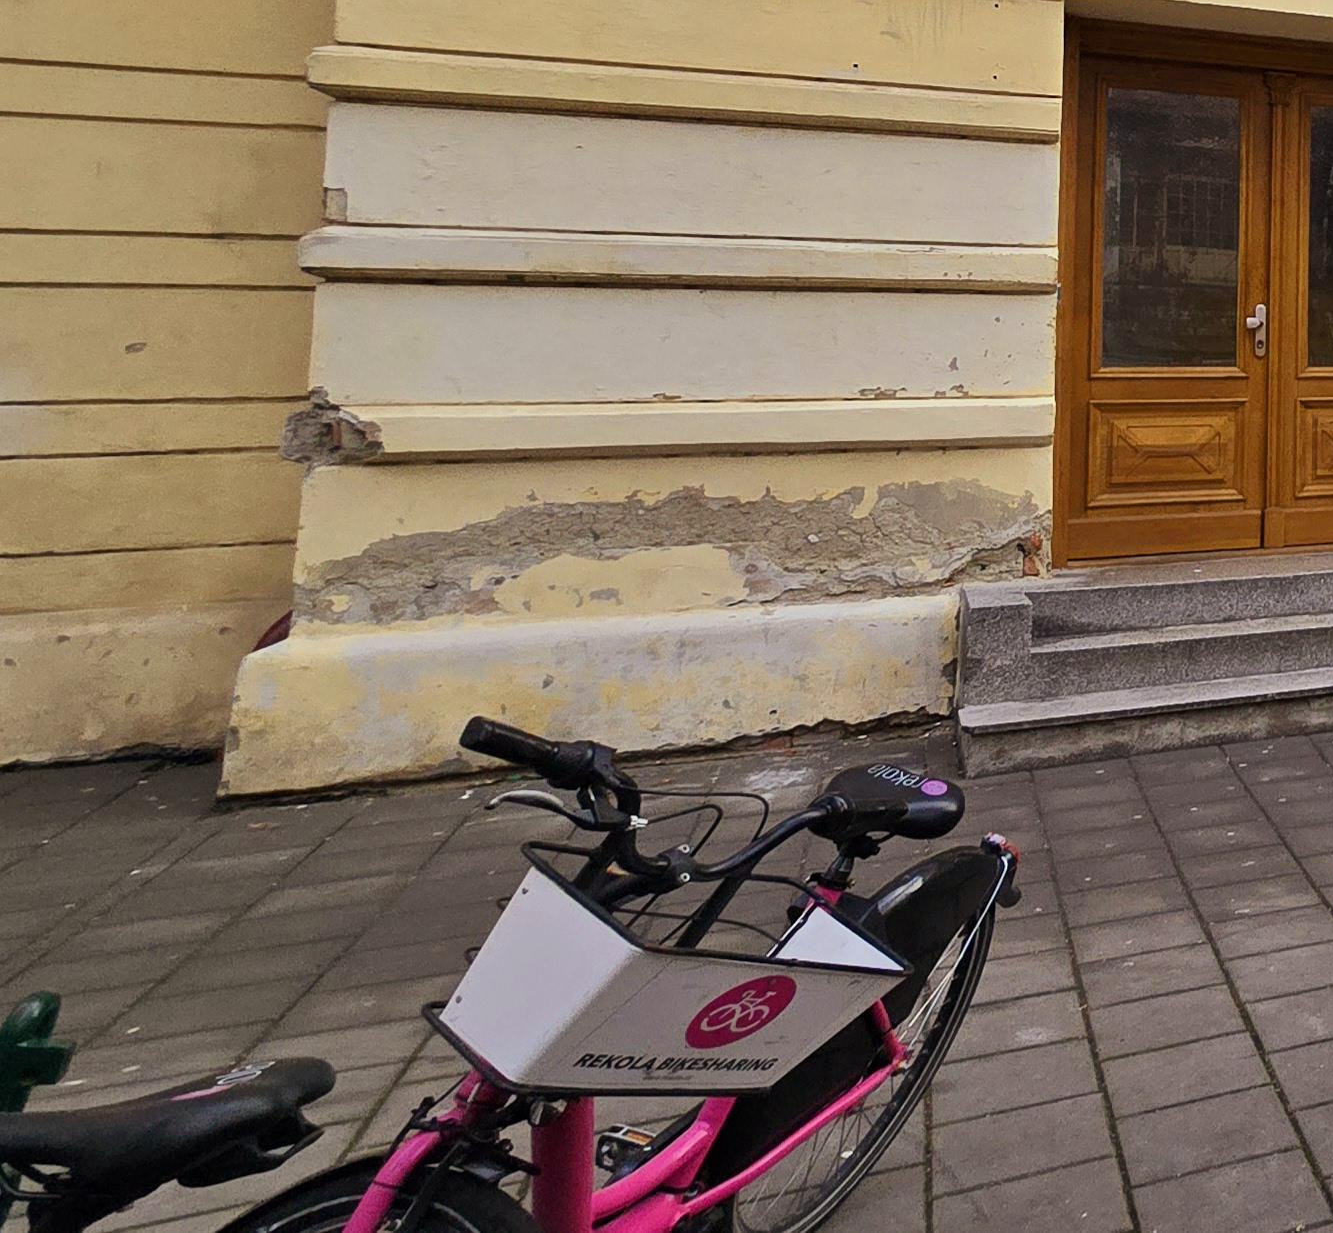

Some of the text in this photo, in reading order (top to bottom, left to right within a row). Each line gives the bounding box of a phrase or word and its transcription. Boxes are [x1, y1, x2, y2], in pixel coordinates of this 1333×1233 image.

[867, 764, 929, 789] rekola
[573, 1053, 778, 1073] REKOLA BIKESHARING
